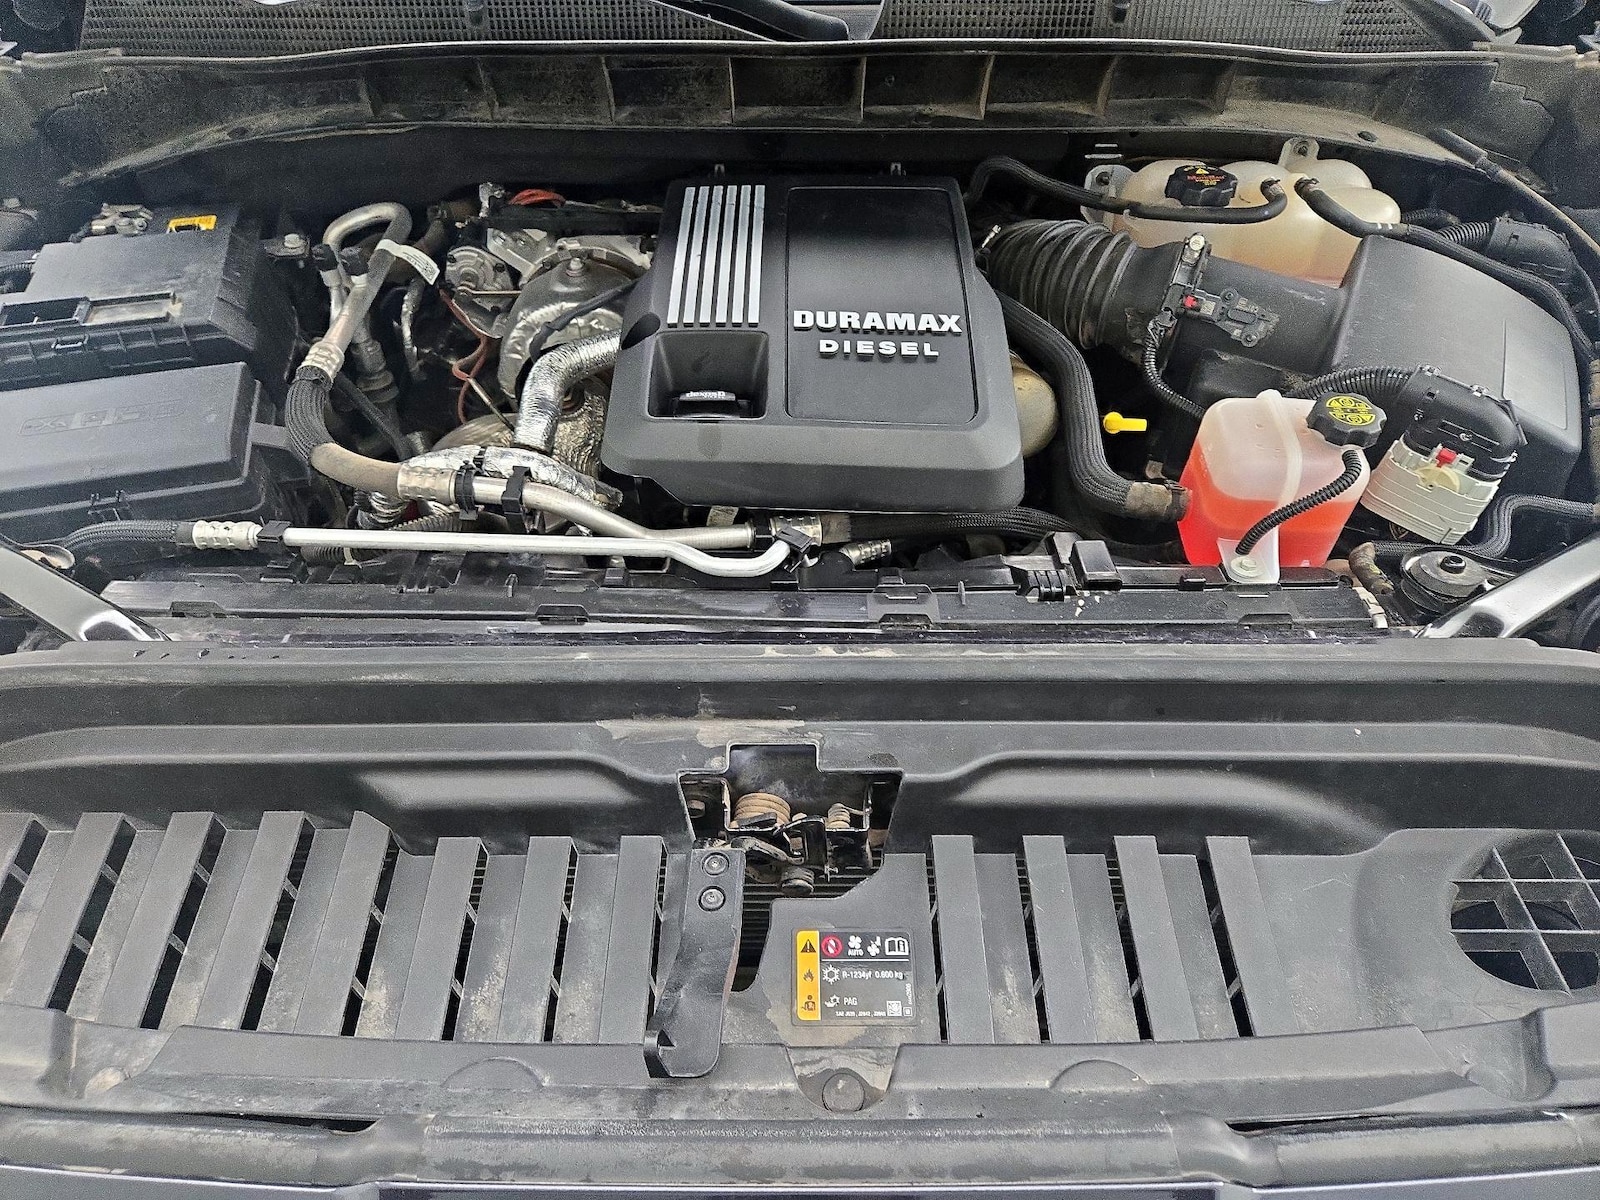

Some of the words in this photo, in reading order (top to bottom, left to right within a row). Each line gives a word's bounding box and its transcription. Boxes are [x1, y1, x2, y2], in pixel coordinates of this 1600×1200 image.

[793, 310, 963, 335] DURAMAX
[819, 339, 939, 358] DIESEL
[842, 970, 872, 980] R-1234yf
[894, 970, 904, 980] kg
[843, 997, 858, 1006] PAG
